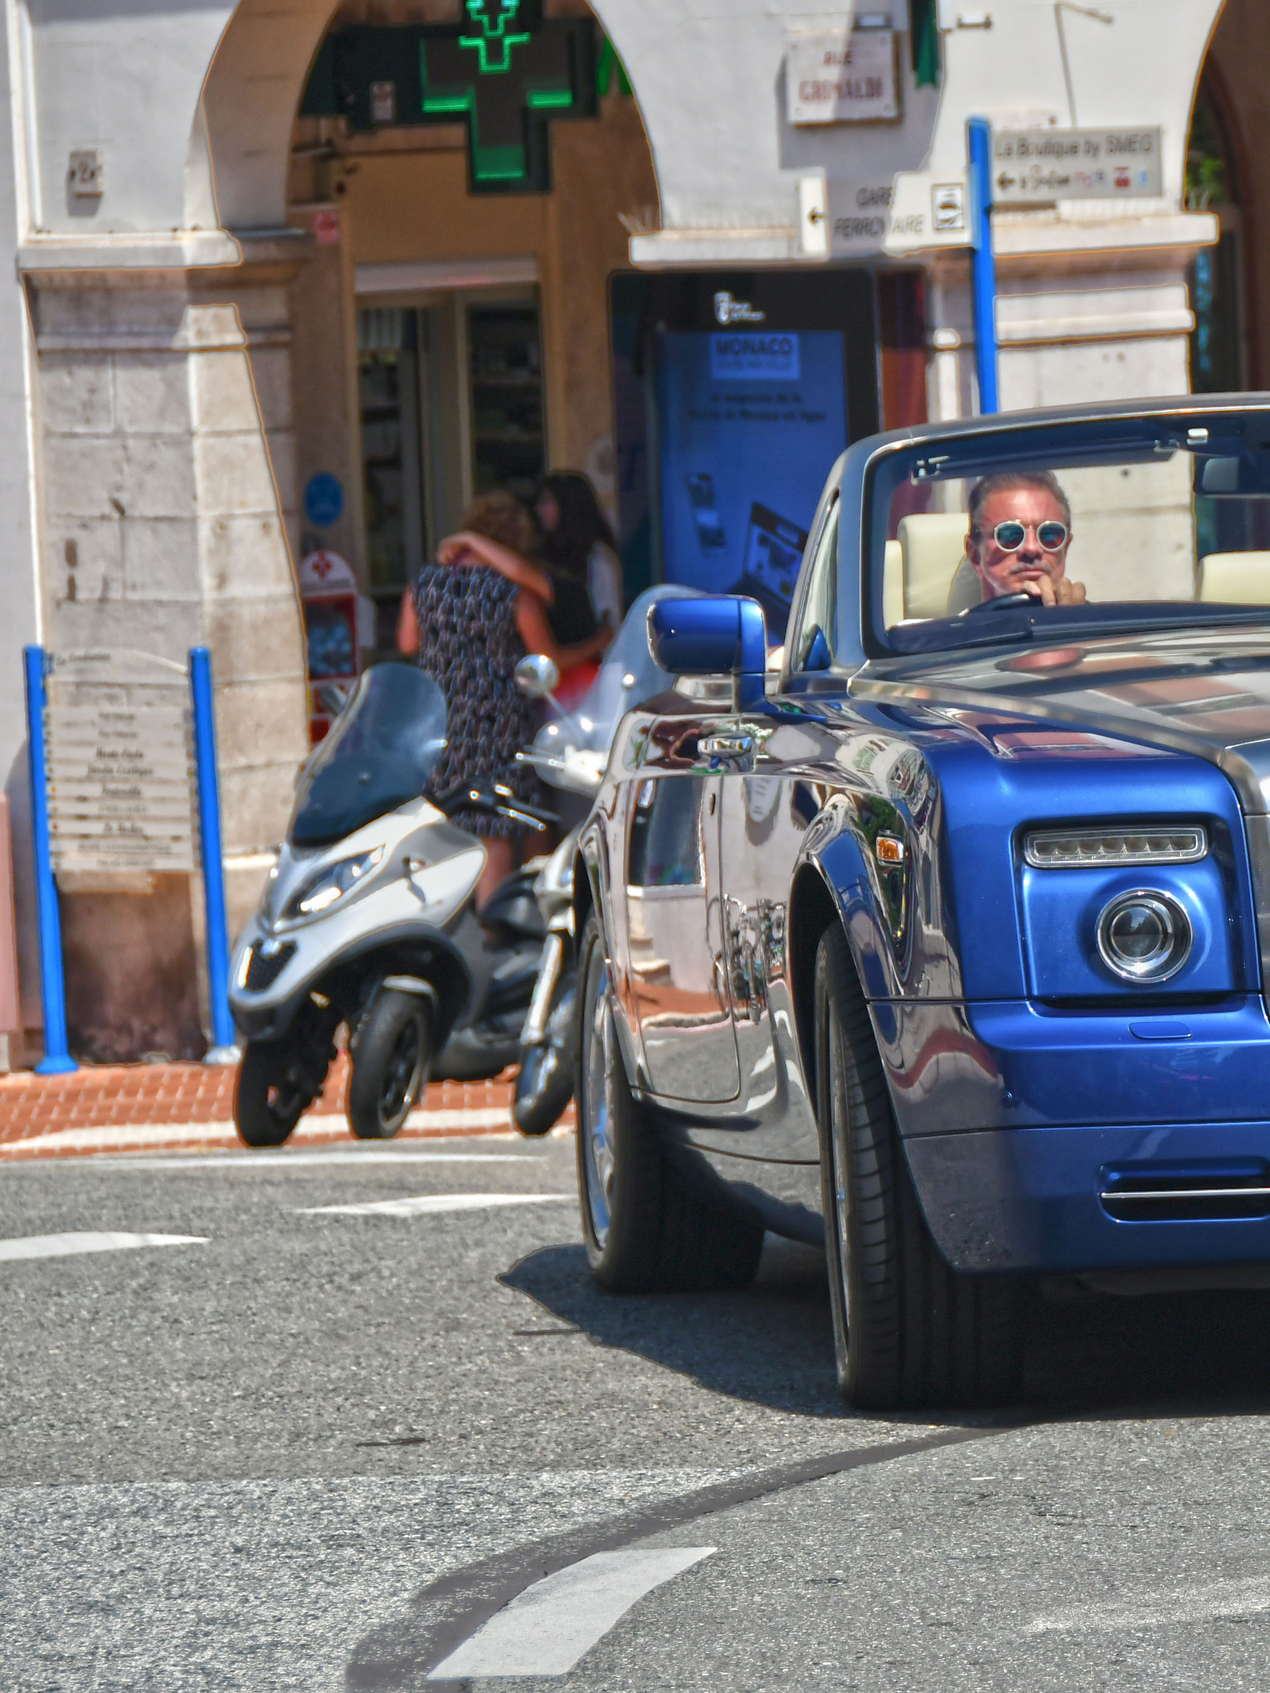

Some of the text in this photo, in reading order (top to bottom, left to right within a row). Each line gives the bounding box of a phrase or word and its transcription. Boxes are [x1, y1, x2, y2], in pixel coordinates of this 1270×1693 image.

[823, 50, 852, 67] RUE
[798, 76, 883, 102] GRIMALDI
[995, 133, 1153, 162] La Boutique by SMEG
[855, 184, 893, 211] GARE
[714, 336, 793, 357] MONACO
